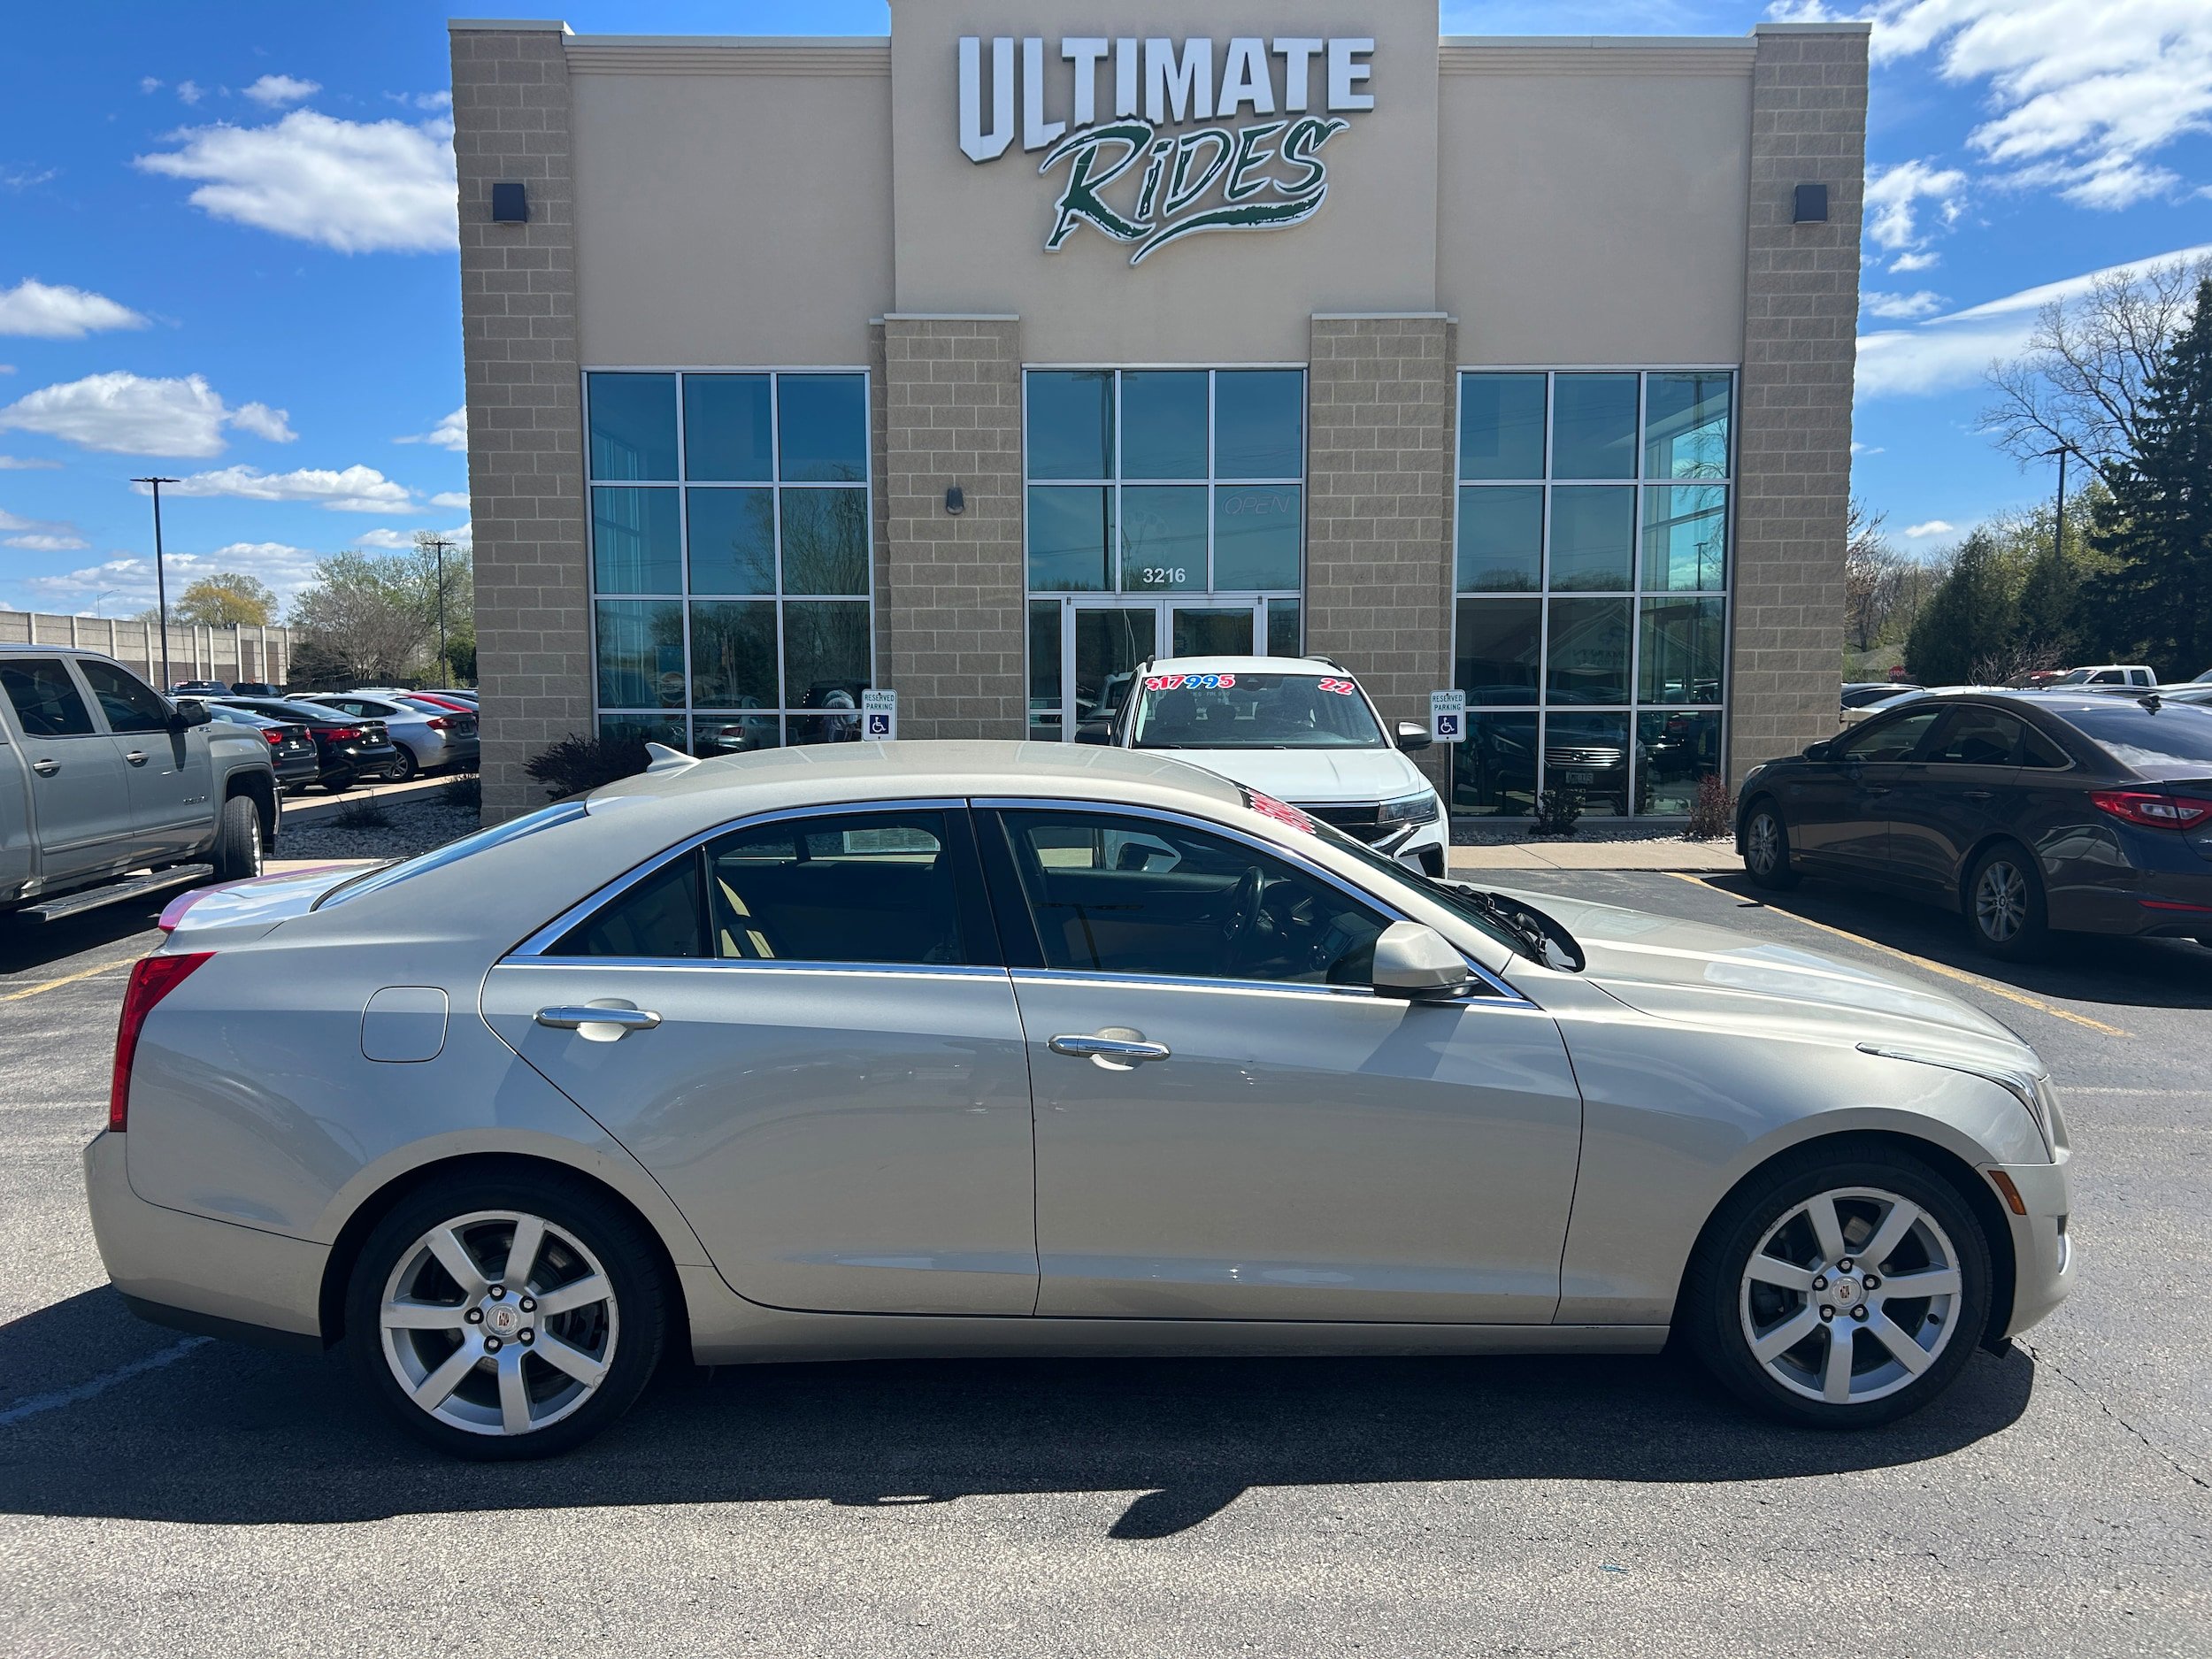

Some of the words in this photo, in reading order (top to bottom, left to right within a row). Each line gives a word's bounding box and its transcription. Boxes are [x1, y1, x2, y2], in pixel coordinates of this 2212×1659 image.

[959, 36, 1374, 165] ULTIMATE
[1225, 496, 1291, 515] OPEN
[1142, 567, 1186, 583] 3216
[1145, 674, 1235, 691] $17995
[1317, 677, 1355, 695] 22
